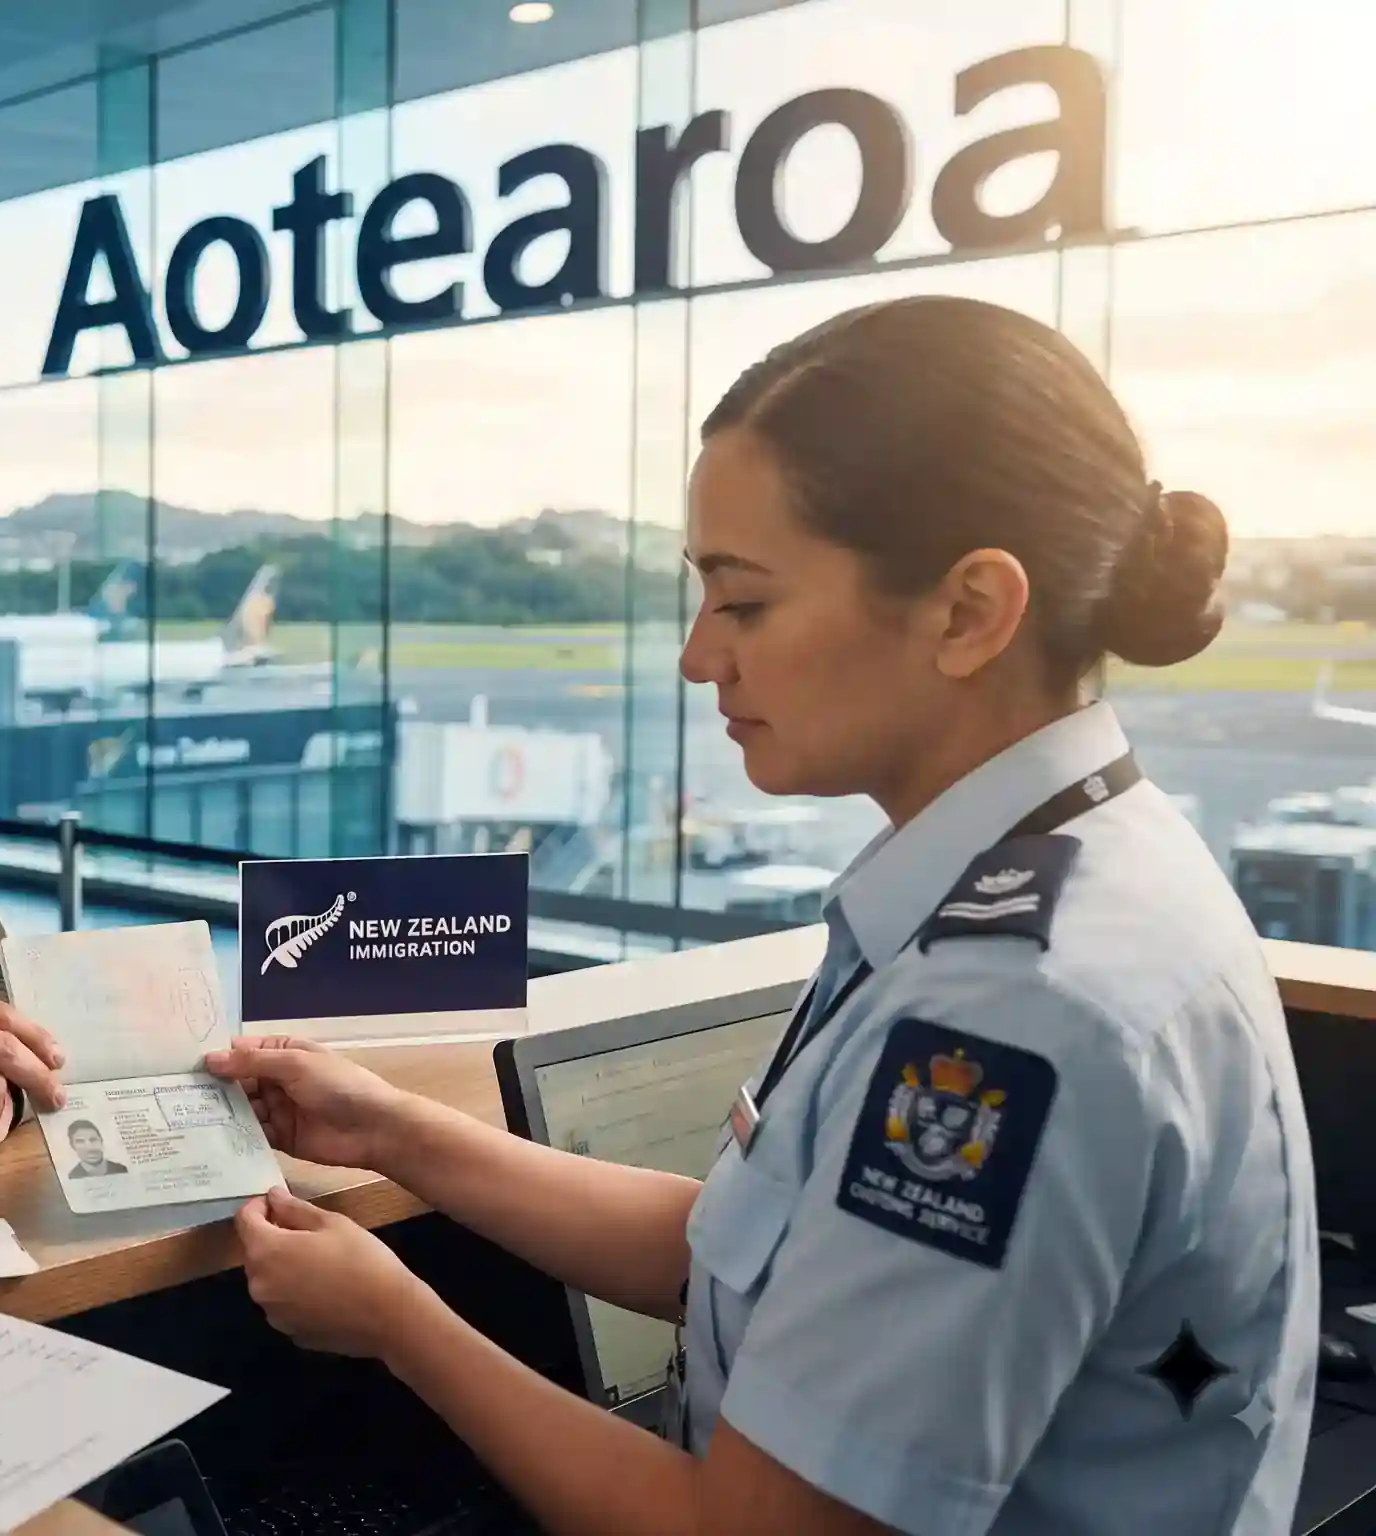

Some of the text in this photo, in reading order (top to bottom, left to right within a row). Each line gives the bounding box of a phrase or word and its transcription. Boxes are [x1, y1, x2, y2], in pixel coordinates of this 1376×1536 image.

[41, 44, 1108, 376] Aotearoa
[349, 914, 512, 940] NEW ZEALAND
[349, 940, 476, 960] IMMIGRATION
